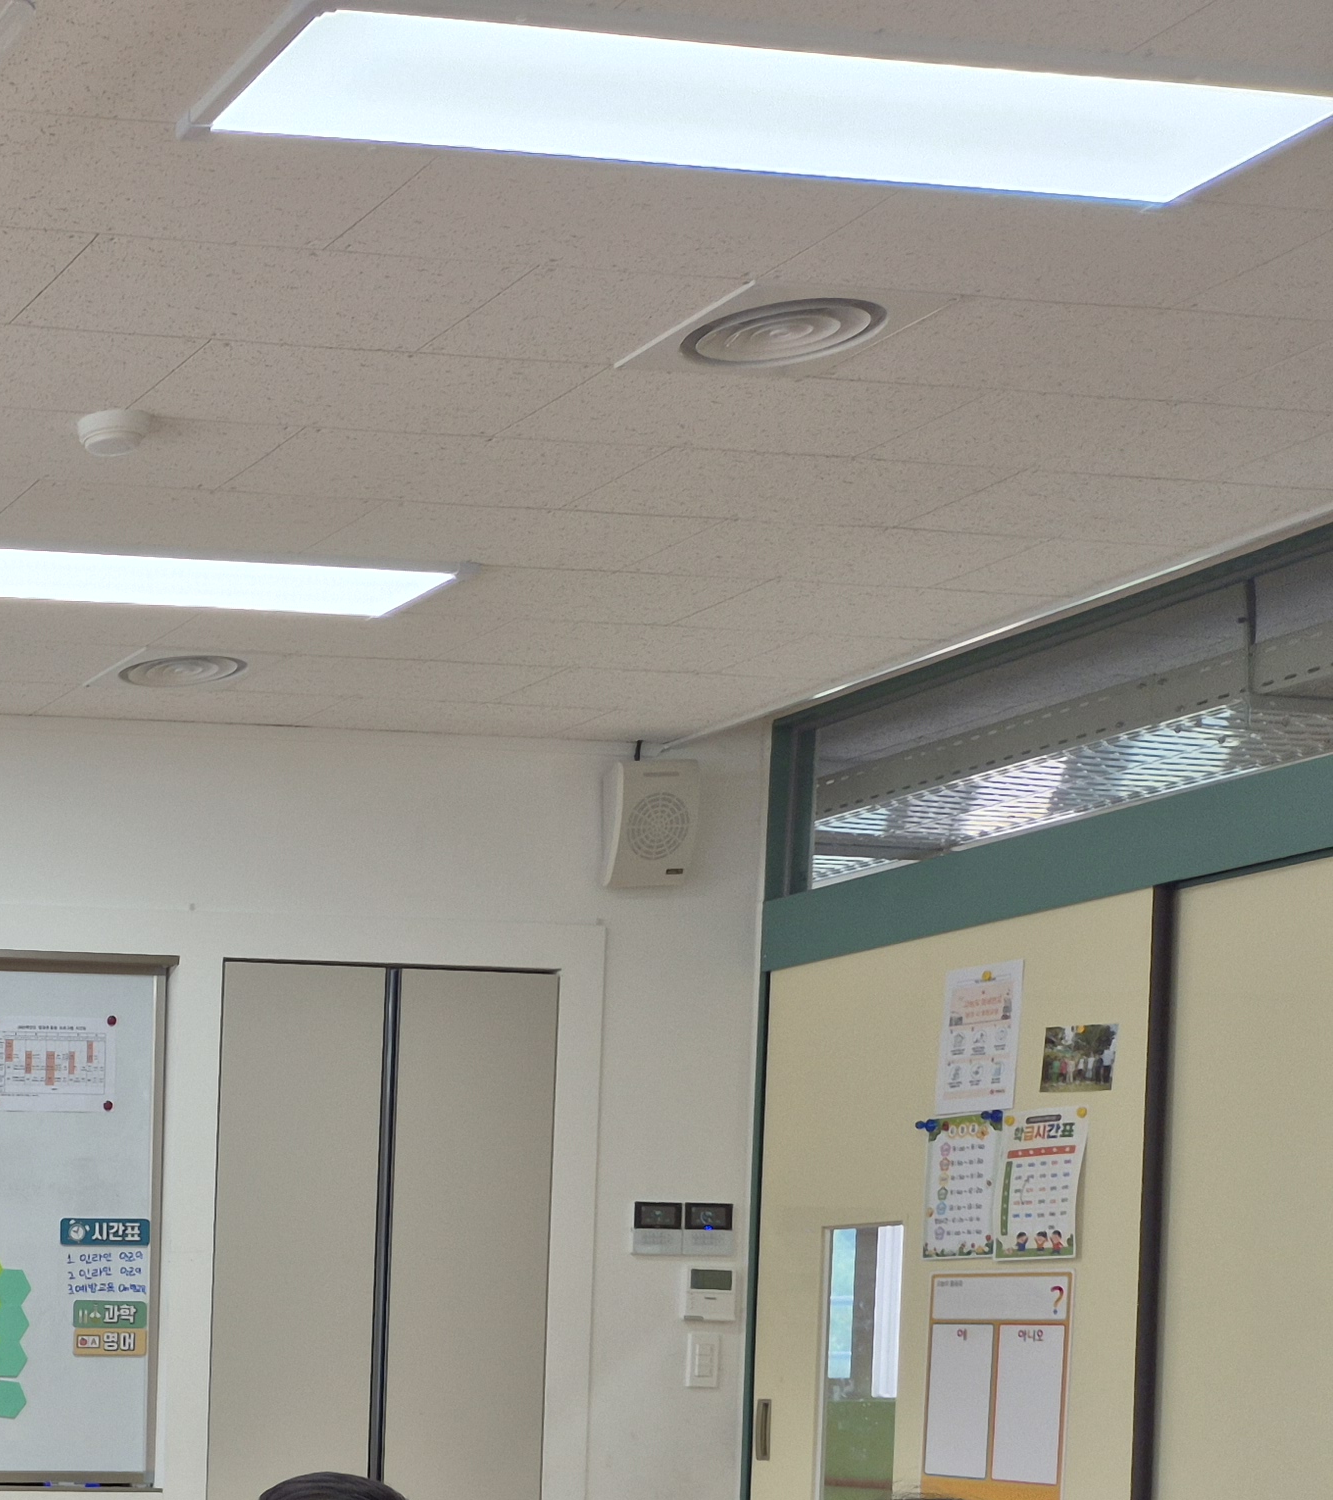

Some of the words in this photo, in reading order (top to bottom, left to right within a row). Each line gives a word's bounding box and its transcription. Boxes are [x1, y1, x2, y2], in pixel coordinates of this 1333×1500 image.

[1014, 1122, 1075, 1142] 학급시간표
[91, 1222, 141, 1241] 시간표
[67, 1254, 75, 1264] 1
[68, 1271, 76, 1280] 2
[103, 1304, 137, 1324] 과학
[103, 1331, 135, 1352] 영어
